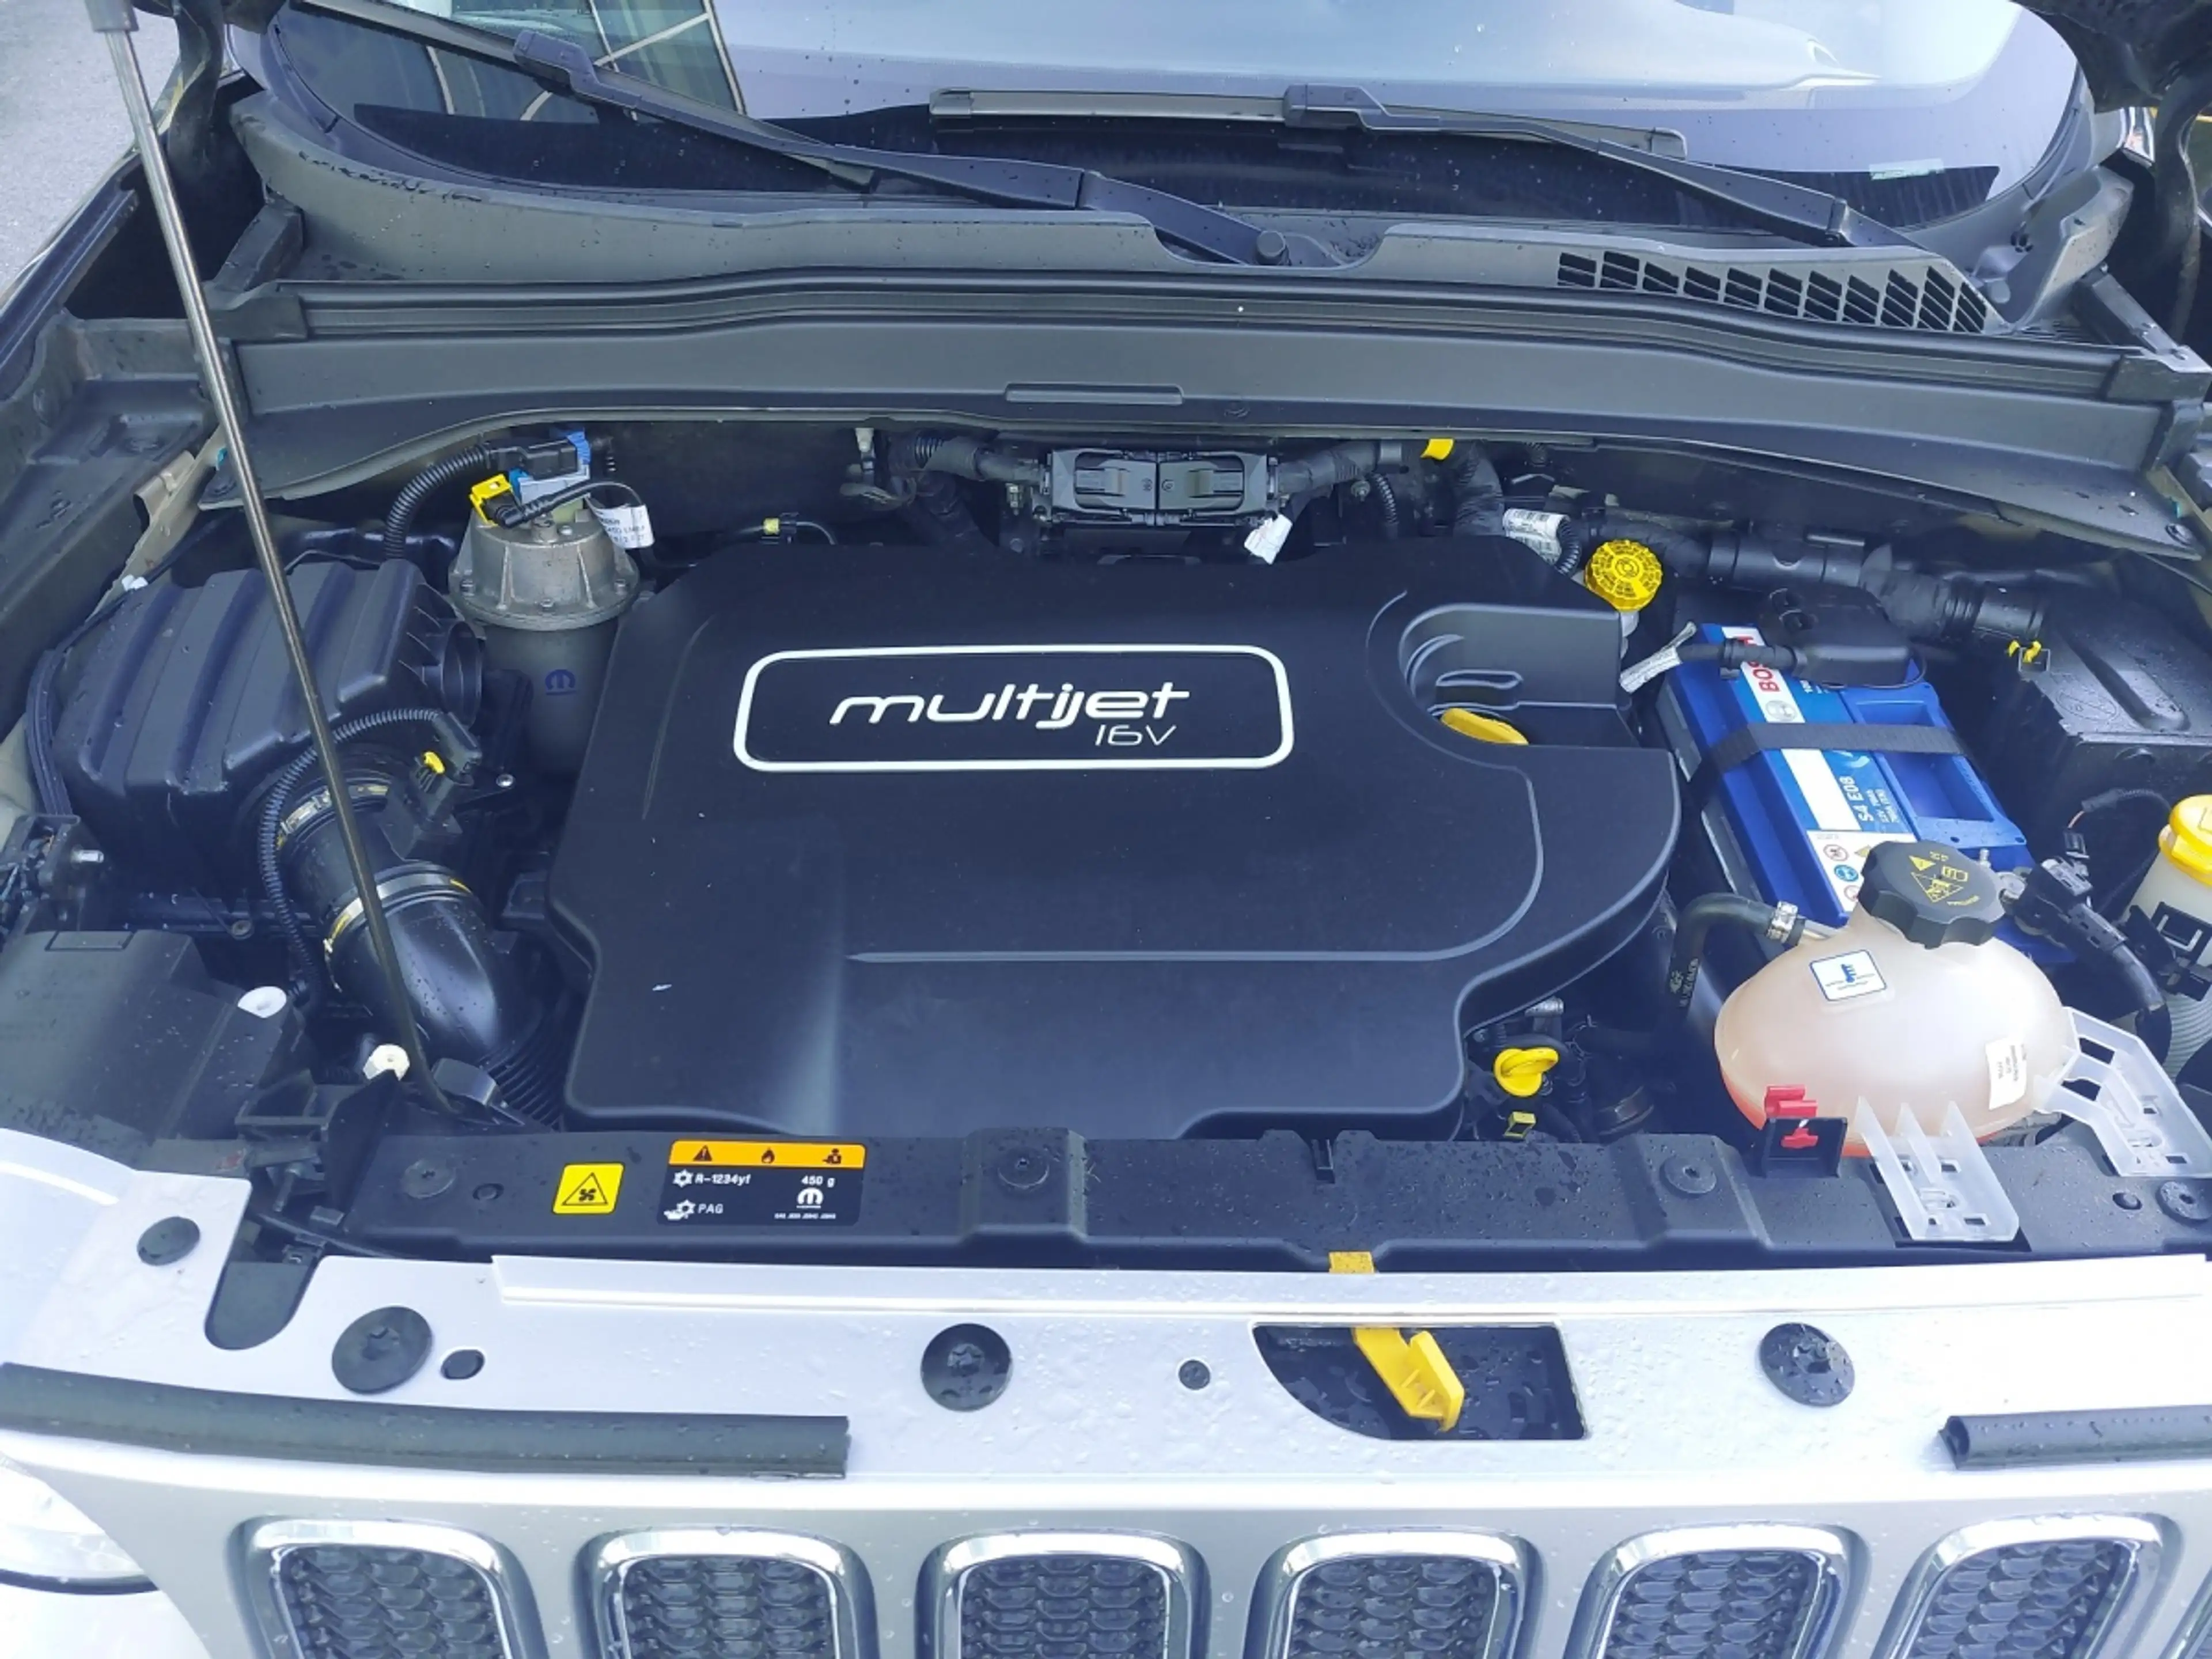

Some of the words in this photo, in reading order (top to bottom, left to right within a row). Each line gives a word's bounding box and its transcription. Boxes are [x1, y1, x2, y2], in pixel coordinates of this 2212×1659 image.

[829, 682, 1190, 730] multijet
[1095, 724, 1177, 747] 16V
[695, 1173, 751, 1187] R-1234yf
[801, 1175, 823, 1185] 450
[698, 1203, 724, 1214] PAG
